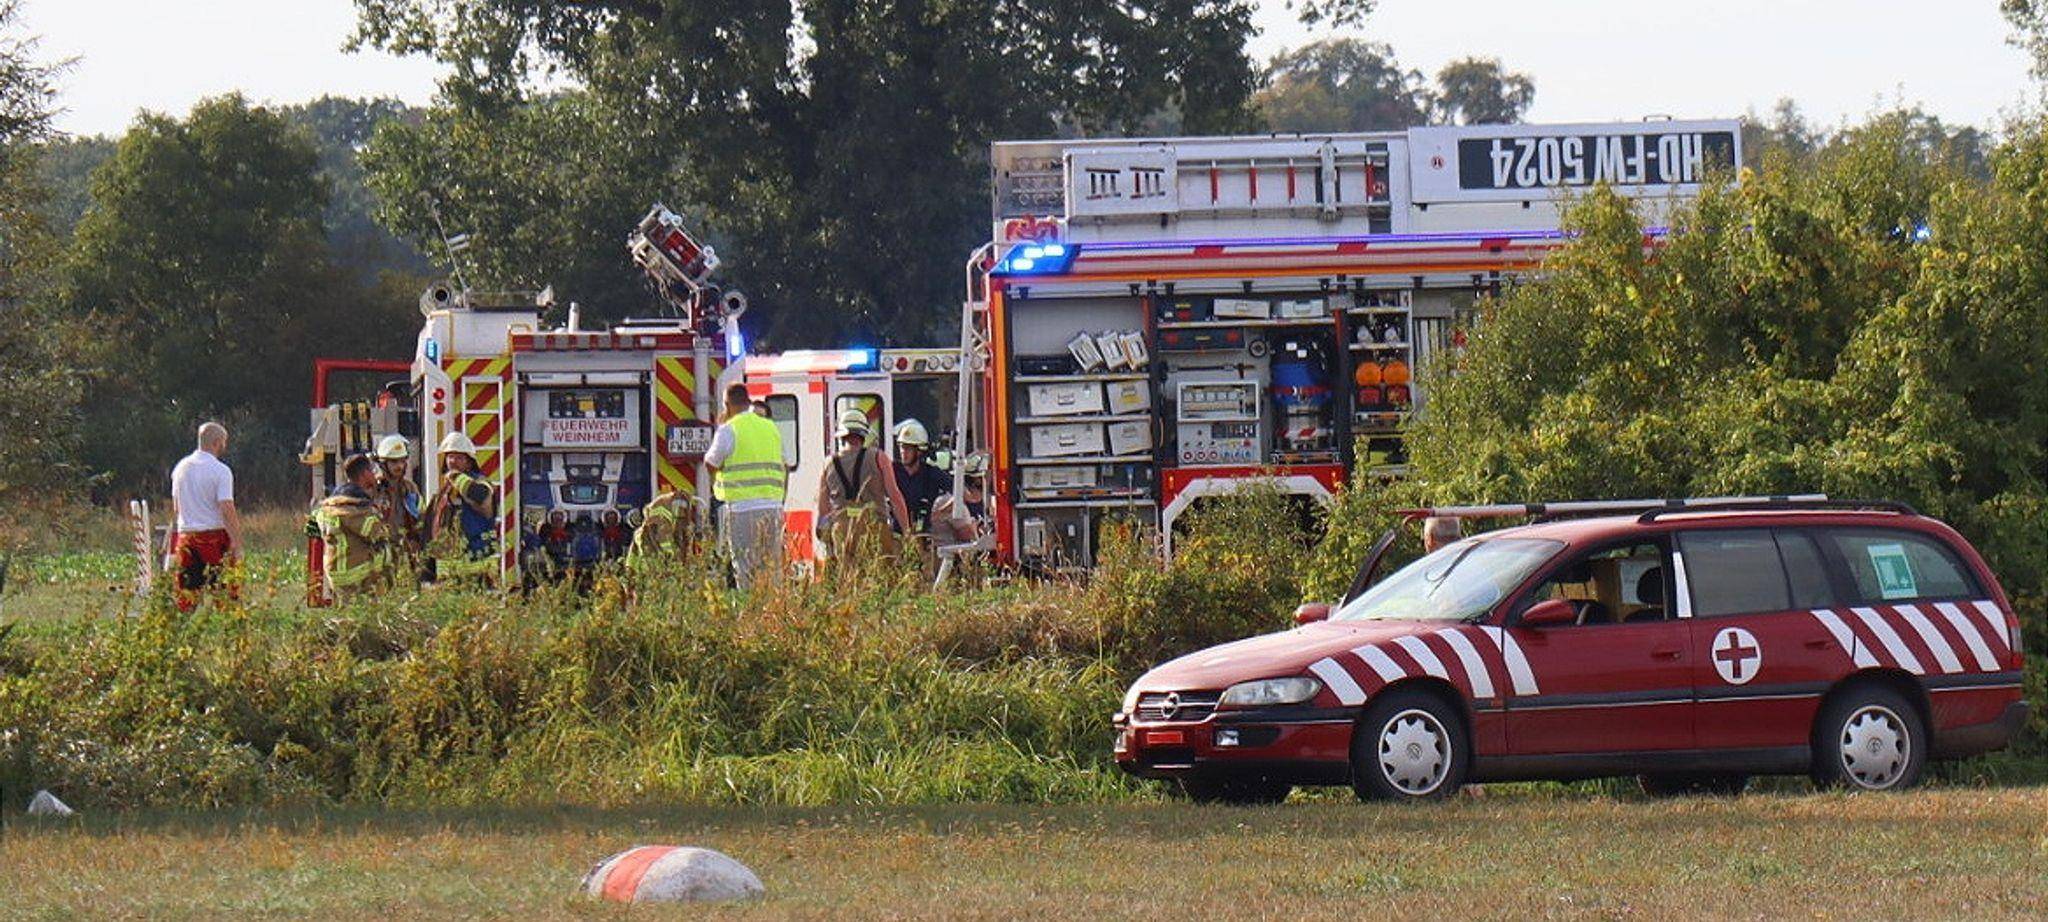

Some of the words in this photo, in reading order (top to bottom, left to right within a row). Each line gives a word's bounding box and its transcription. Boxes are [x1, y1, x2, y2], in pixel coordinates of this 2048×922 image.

[1490, 137, 1585, 188] 5024
[1594, 133, 1702, 184] HD-FW
[541, 419, 628, 431] FEUERWEHR
[553, 432, 620, 442] WEINHEIM
[680, 429, 694, 440] HD
